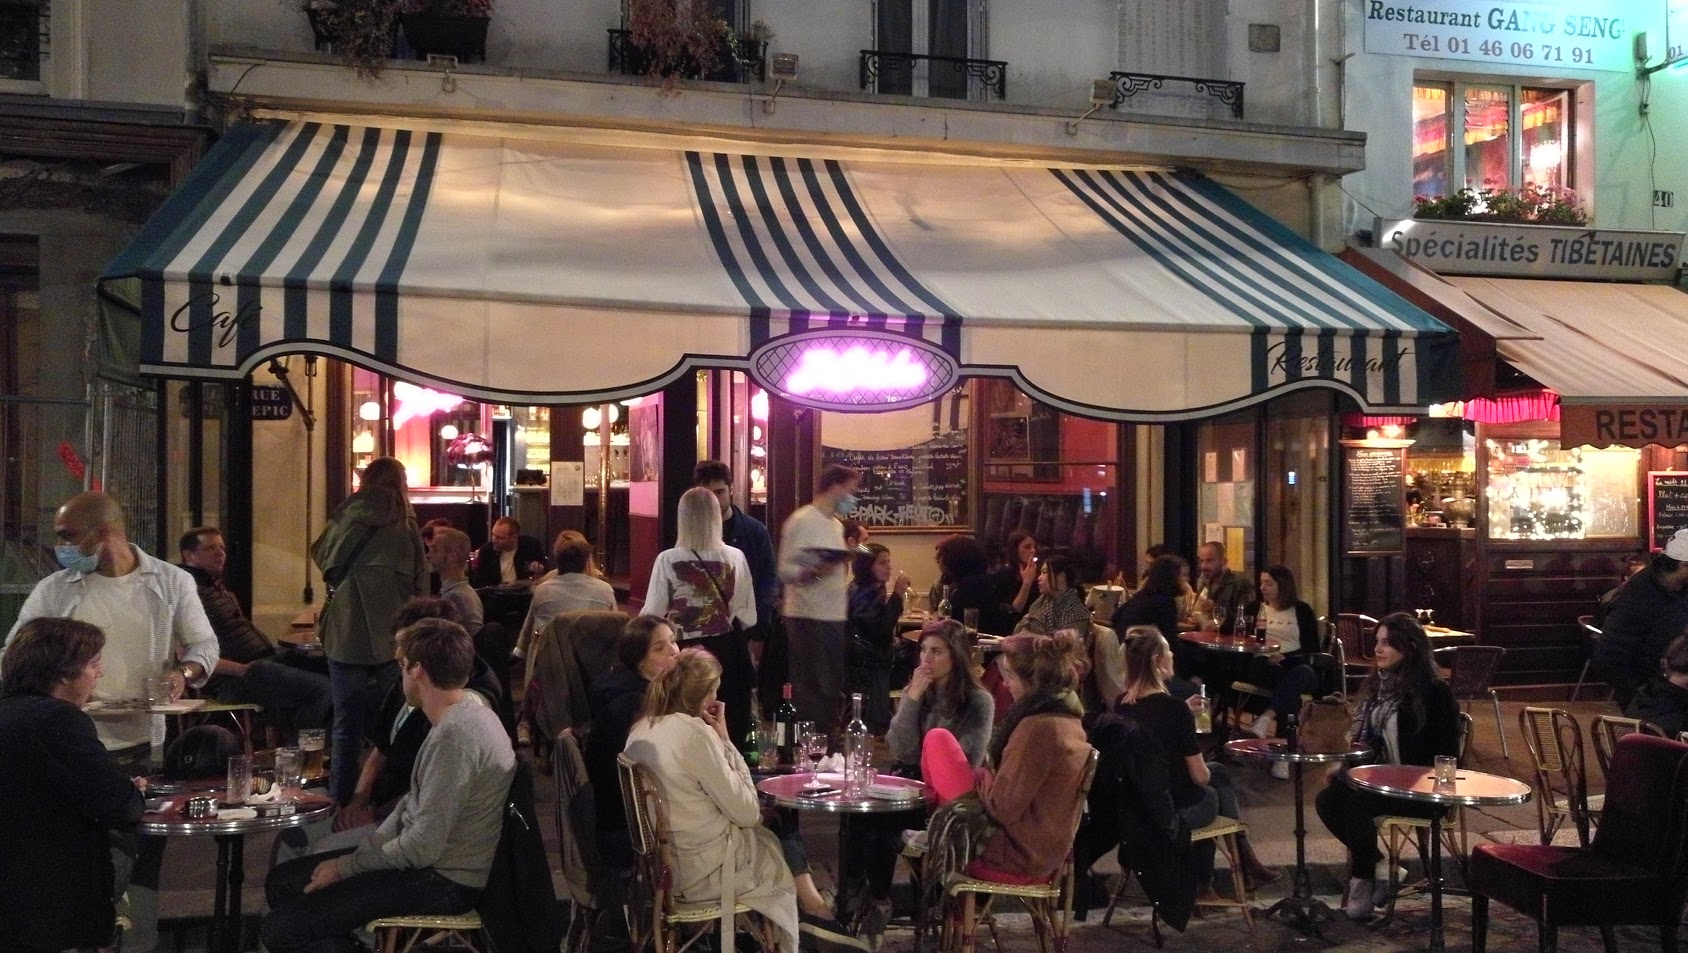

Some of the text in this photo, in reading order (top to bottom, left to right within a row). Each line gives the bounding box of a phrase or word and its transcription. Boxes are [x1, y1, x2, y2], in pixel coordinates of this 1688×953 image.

[1368, 0, 1481, 28] Restaurant
[1403, 33, 1594, 64] Tél 01 46 06 71 91
[1654, 190, 1674, 207] 40
[1391, 230, 1540, 264] Spécialités
[171, 292, 264, 348] Café
[252, 405, 288, 416] EPIC
